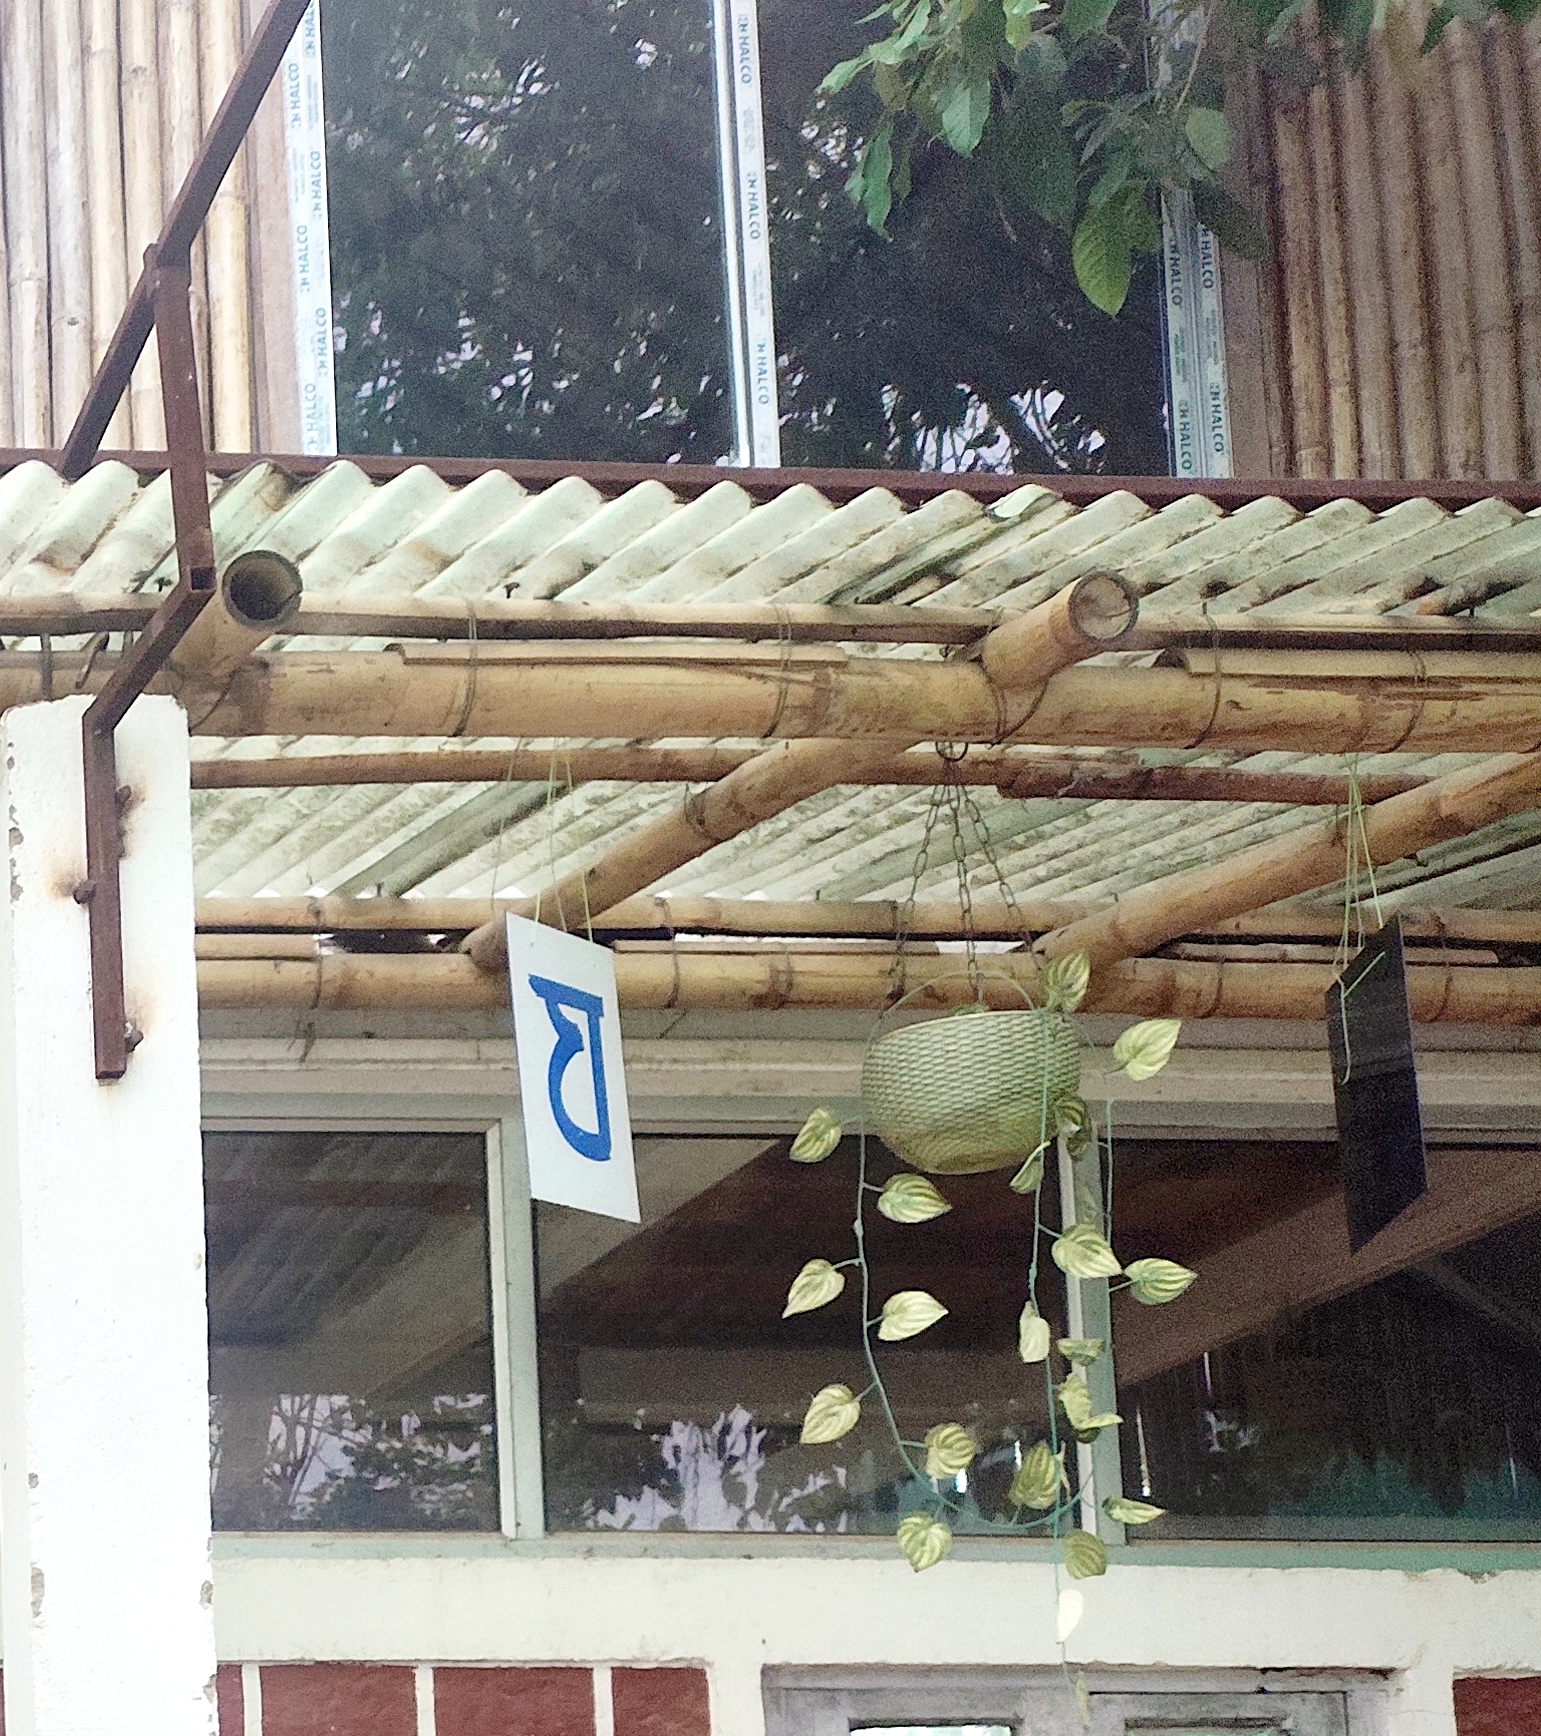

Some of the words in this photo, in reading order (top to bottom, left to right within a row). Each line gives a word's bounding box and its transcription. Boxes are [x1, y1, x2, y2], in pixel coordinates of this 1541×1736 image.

[740, 36, 753, 84] HALCO
[288, 63, 301, 110] HALCO
[310, 150, 322, 199] HALCO
[748, 192, 761, 240] HALCO
[296, 225, 310, 274] HALCO
[1200, 240, 1215, 289] HALCO
[1169, 257, 1183, 306] HALCO
[315, 307, 327, 356] HALCO
[757, 355, 770, 405] HALCO
[304, 383, 317, 431] HALCO
[1211, 405, 1224, 453] HALCO
[1179, 422, 1193, 470] HALCO
